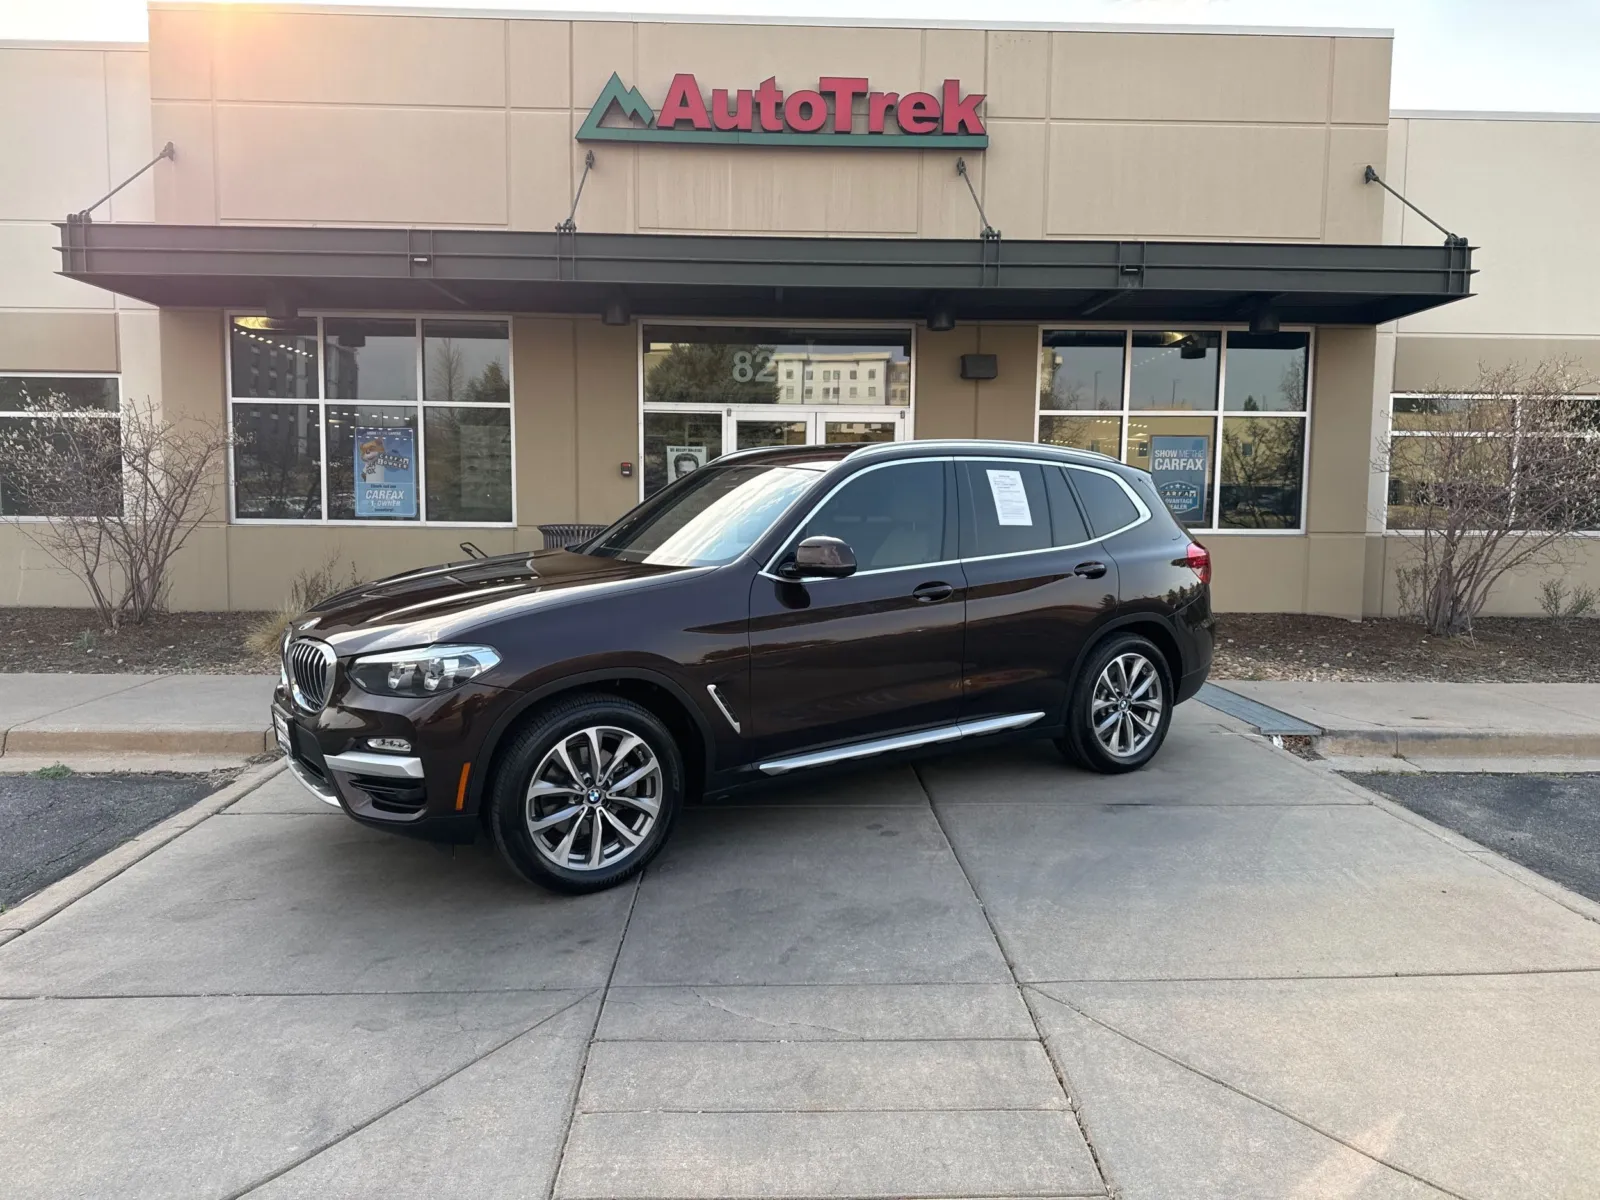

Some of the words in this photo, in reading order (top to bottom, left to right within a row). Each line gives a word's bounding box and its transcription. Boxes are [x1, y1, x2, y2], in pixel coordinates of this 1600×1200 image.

[656, 73, 987, 135] AutoTrek
[733, 351, 776, 382] 82
[1155, 449, 1177, 457] SHOW
[1179, 449, 1189, 457] ME
[1191, 450, 1204, 458] THE
[1155, 458, 1204, 470] CARFAX
[366, 490, 404, 499] CARFAX
